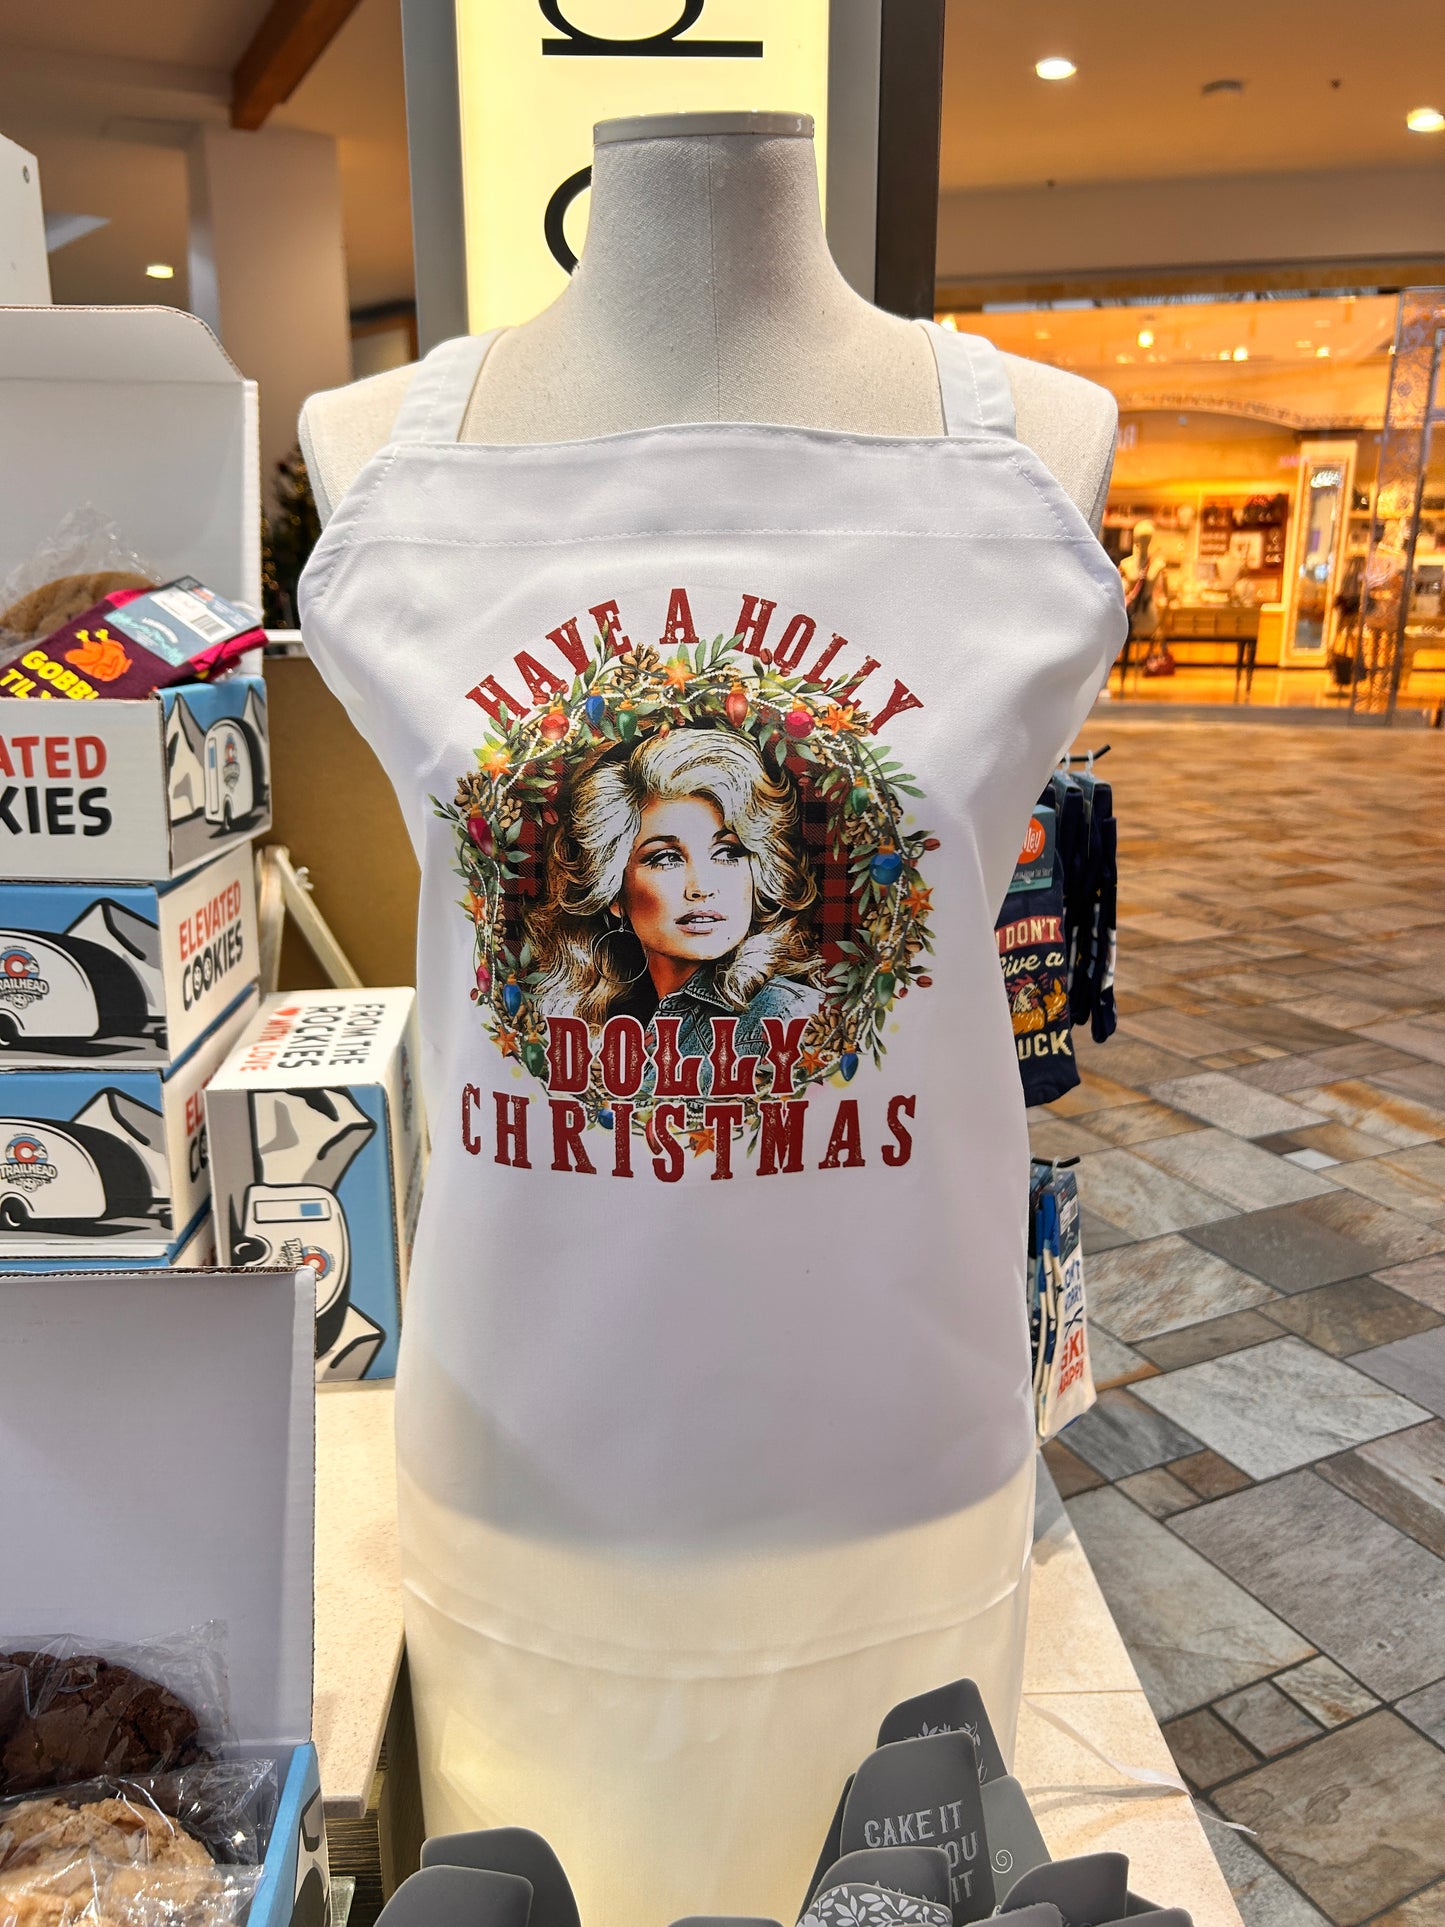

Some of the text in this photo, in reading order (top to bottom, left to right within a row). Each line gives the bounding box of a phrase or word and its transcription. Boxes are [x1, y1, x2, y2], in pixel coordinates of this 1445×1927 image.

[464, 588, 925, 735] HAVE A HOLLY
[179, 880, 241, 962] ELEVATED
[1006, 919, 1057, 949] DON'T
[182, 919, 243, 1012] COOKIES
[1045, 951, 1065, 967] a
[240, 1044, 281, 1071] LOVE
[277, 1006, 346, 1069] ROCKIES
[328, 1003, 386, 1066] FROM THE
[545, 1015, 811, 1098] DOLLY
[462, 1083, 917, 1183] CHRISTMAS
[0, 1163, 57, 1179] TRAILHEAD
[864, 1800, 962, 1848] CAKE IT
[937, 1831, 978, 1868] OU
